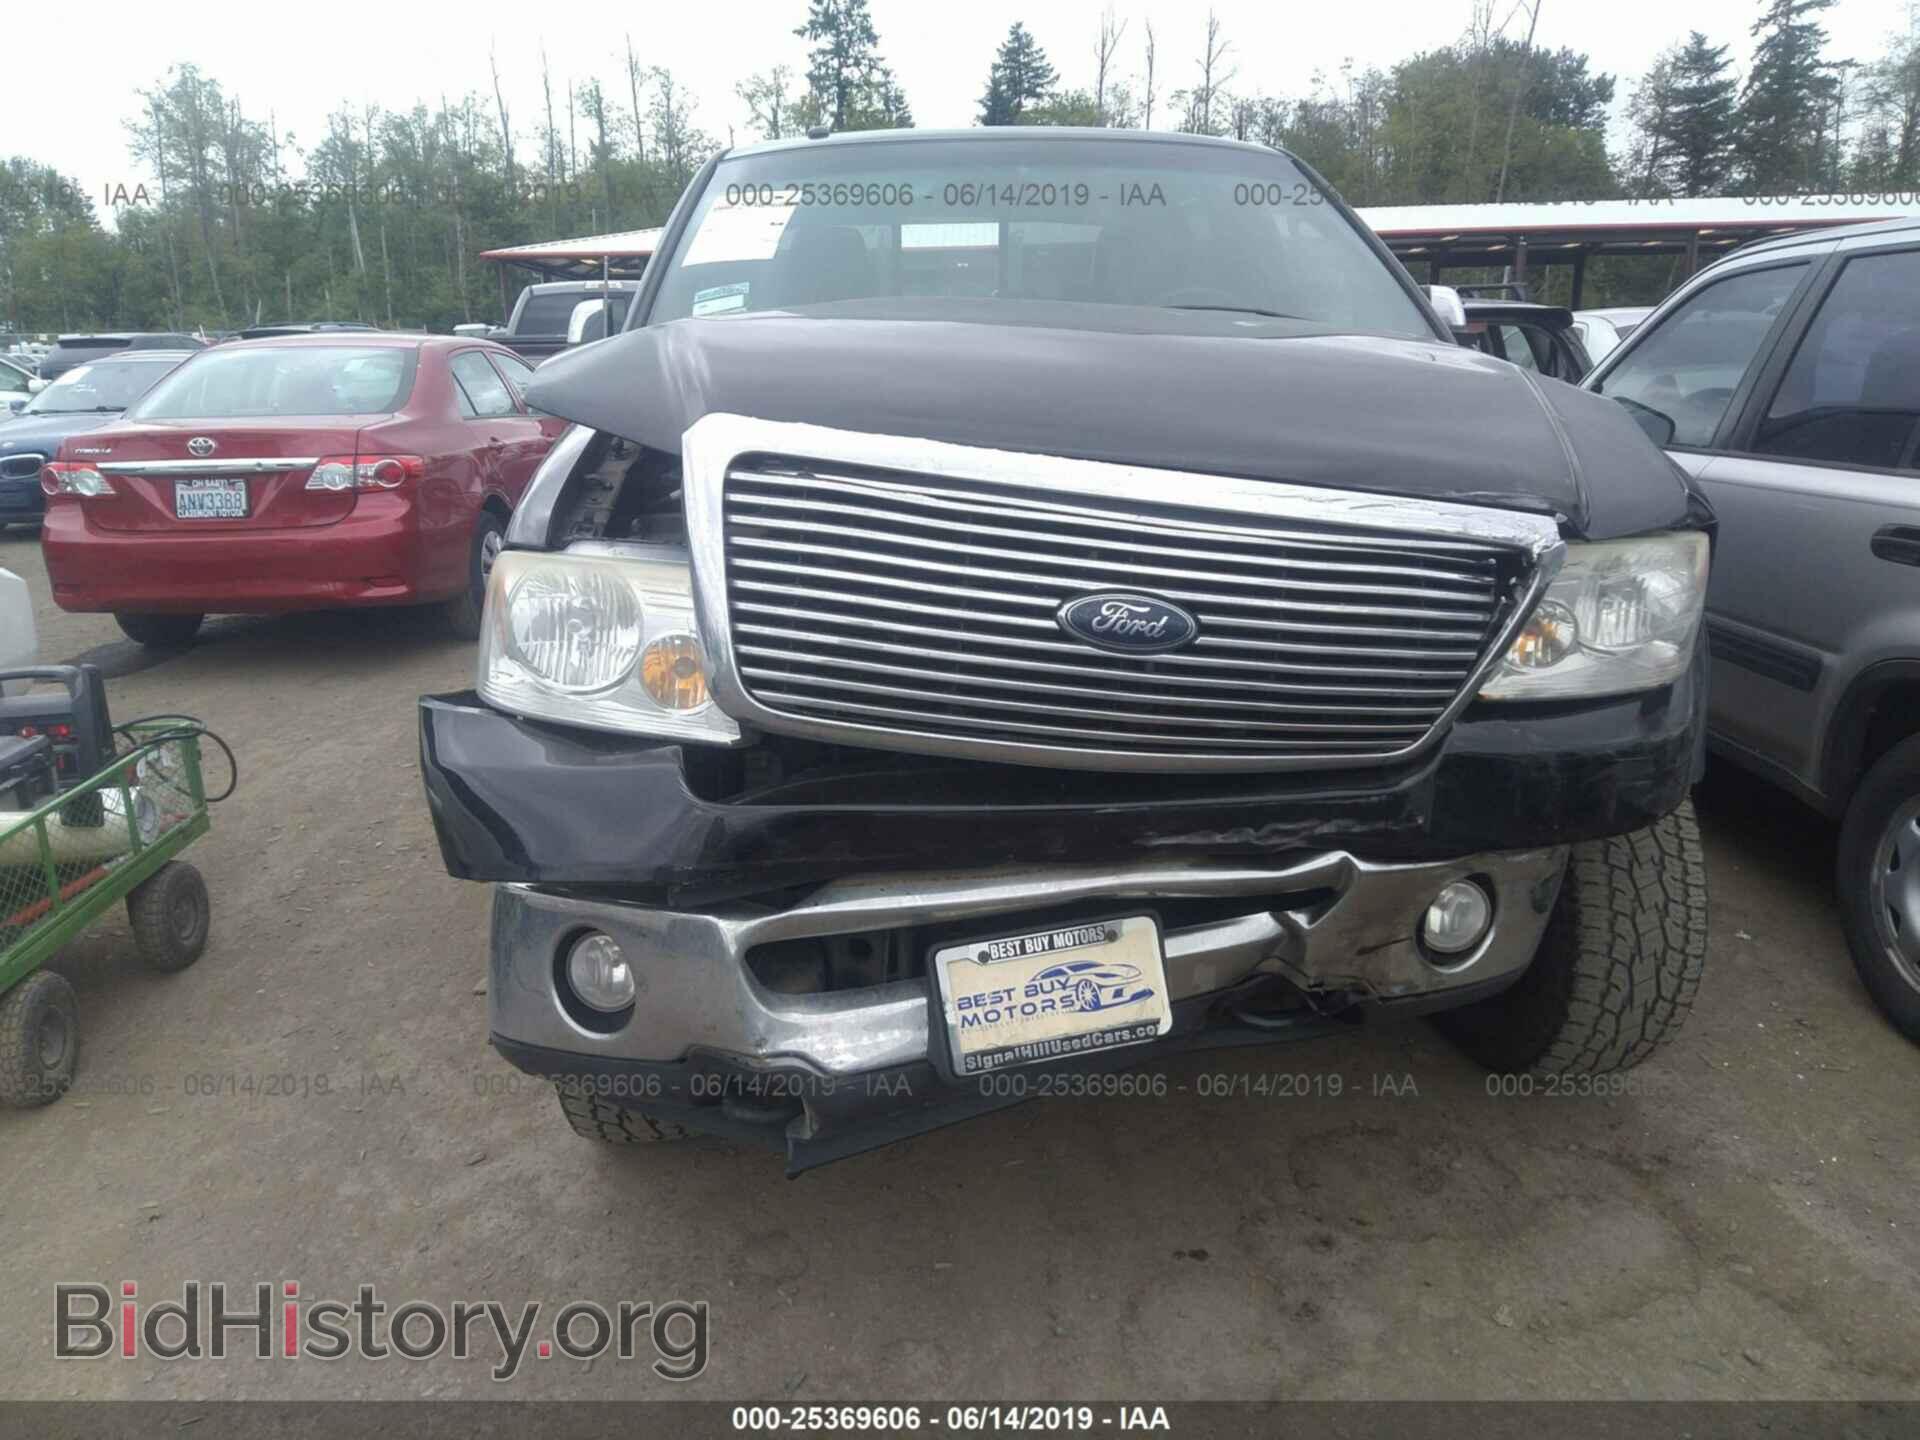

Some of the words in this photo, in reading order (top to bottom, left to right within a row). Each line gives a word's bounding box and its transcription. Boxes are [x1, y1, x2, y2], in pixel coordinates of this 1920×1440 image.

[1092, 601, 1168, 638] Ford
[990, 942, 1022, 959] BEST
[1025, 935, 1052, 953] BUY
[1053, 926, 1105, 949] MOTORS
[958, 987, 1016, 1010] BEST
[1024, 976, 1071, 998] BUY
[960, 993, 1076, 1029] MOTORS
